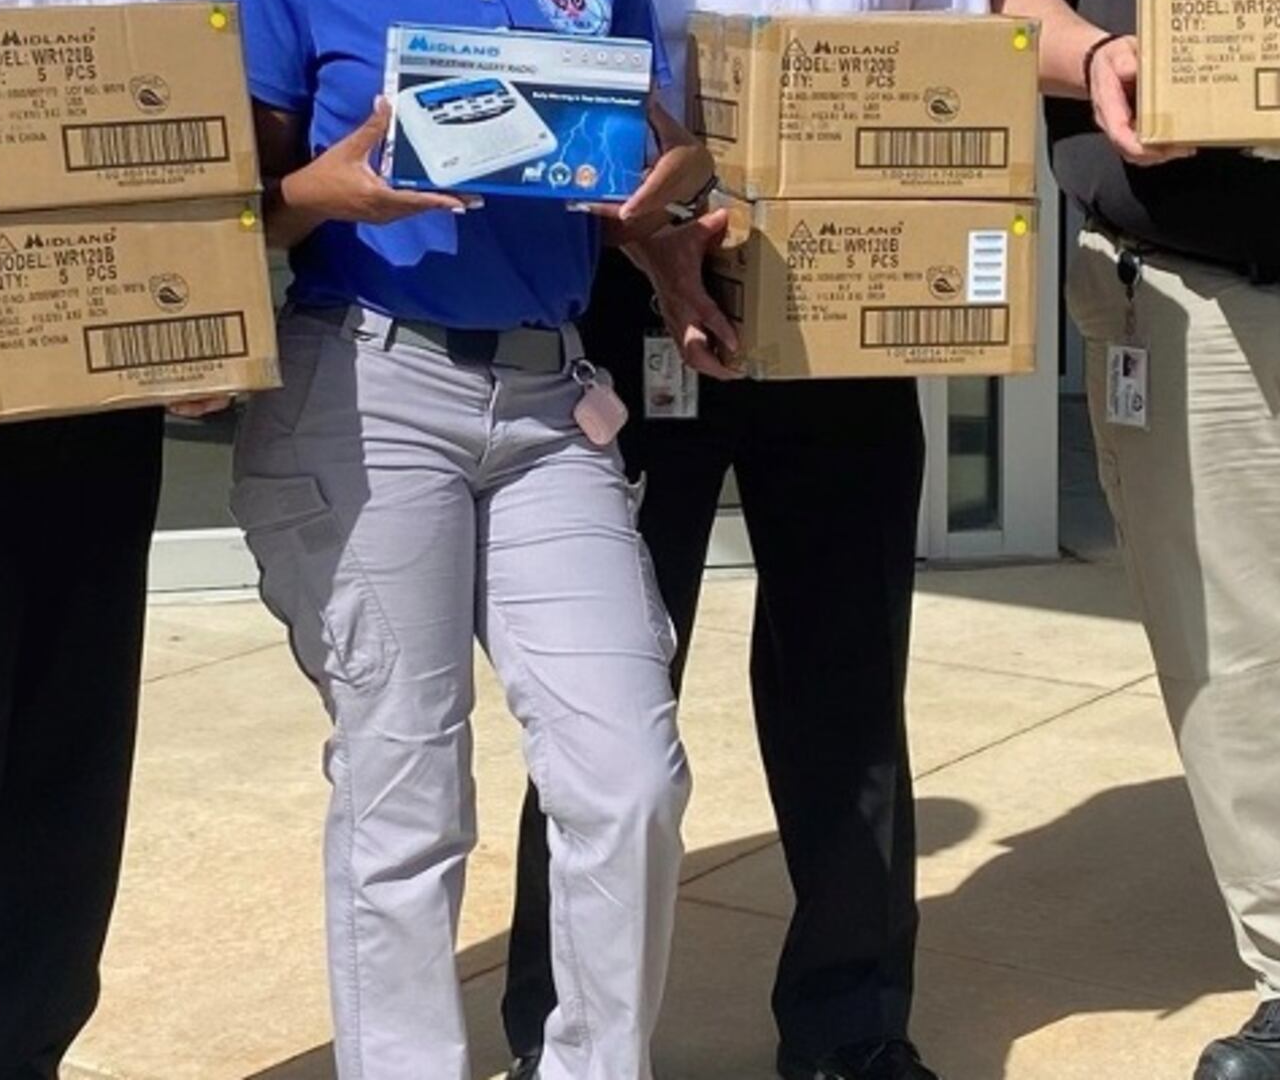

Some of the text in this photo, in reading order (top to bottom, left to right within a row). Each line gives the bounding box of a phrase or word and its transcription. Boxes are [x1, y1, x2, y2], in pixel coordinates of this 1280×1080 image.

[1171, 0, 1229, 15] MODEL:
[1171, 17, 1206, 31] QTY:
[1236, 16, 1246, 29] 5
[1, 30, 96, 47] MIDLAND
[408, 34, 500, 57] MIDLAND
[31, 46, 94, 65] WR120B
[814, 40, 899, 55] MIDLAND
[781, 56, 836, 73] MODEL:
[37, 67, 47, 82] 5
[64, 65, 97, 80] PCS
[780, 73, 813, 88] QTY:
[866, 75, 895, 88] PCS
[819, 222, 902, 236] MIDLAND
[24, 233, 117, 249] MIDLAND
[844, 238, 899, 254] WR120B
[54, 246, 115, 267] WR120B
[846, 254, 856, 269] 5
[871, 254, 899, 269] PCS
[58, 268, 69, 285] 5
[86, 265, 117, 282] PCS
